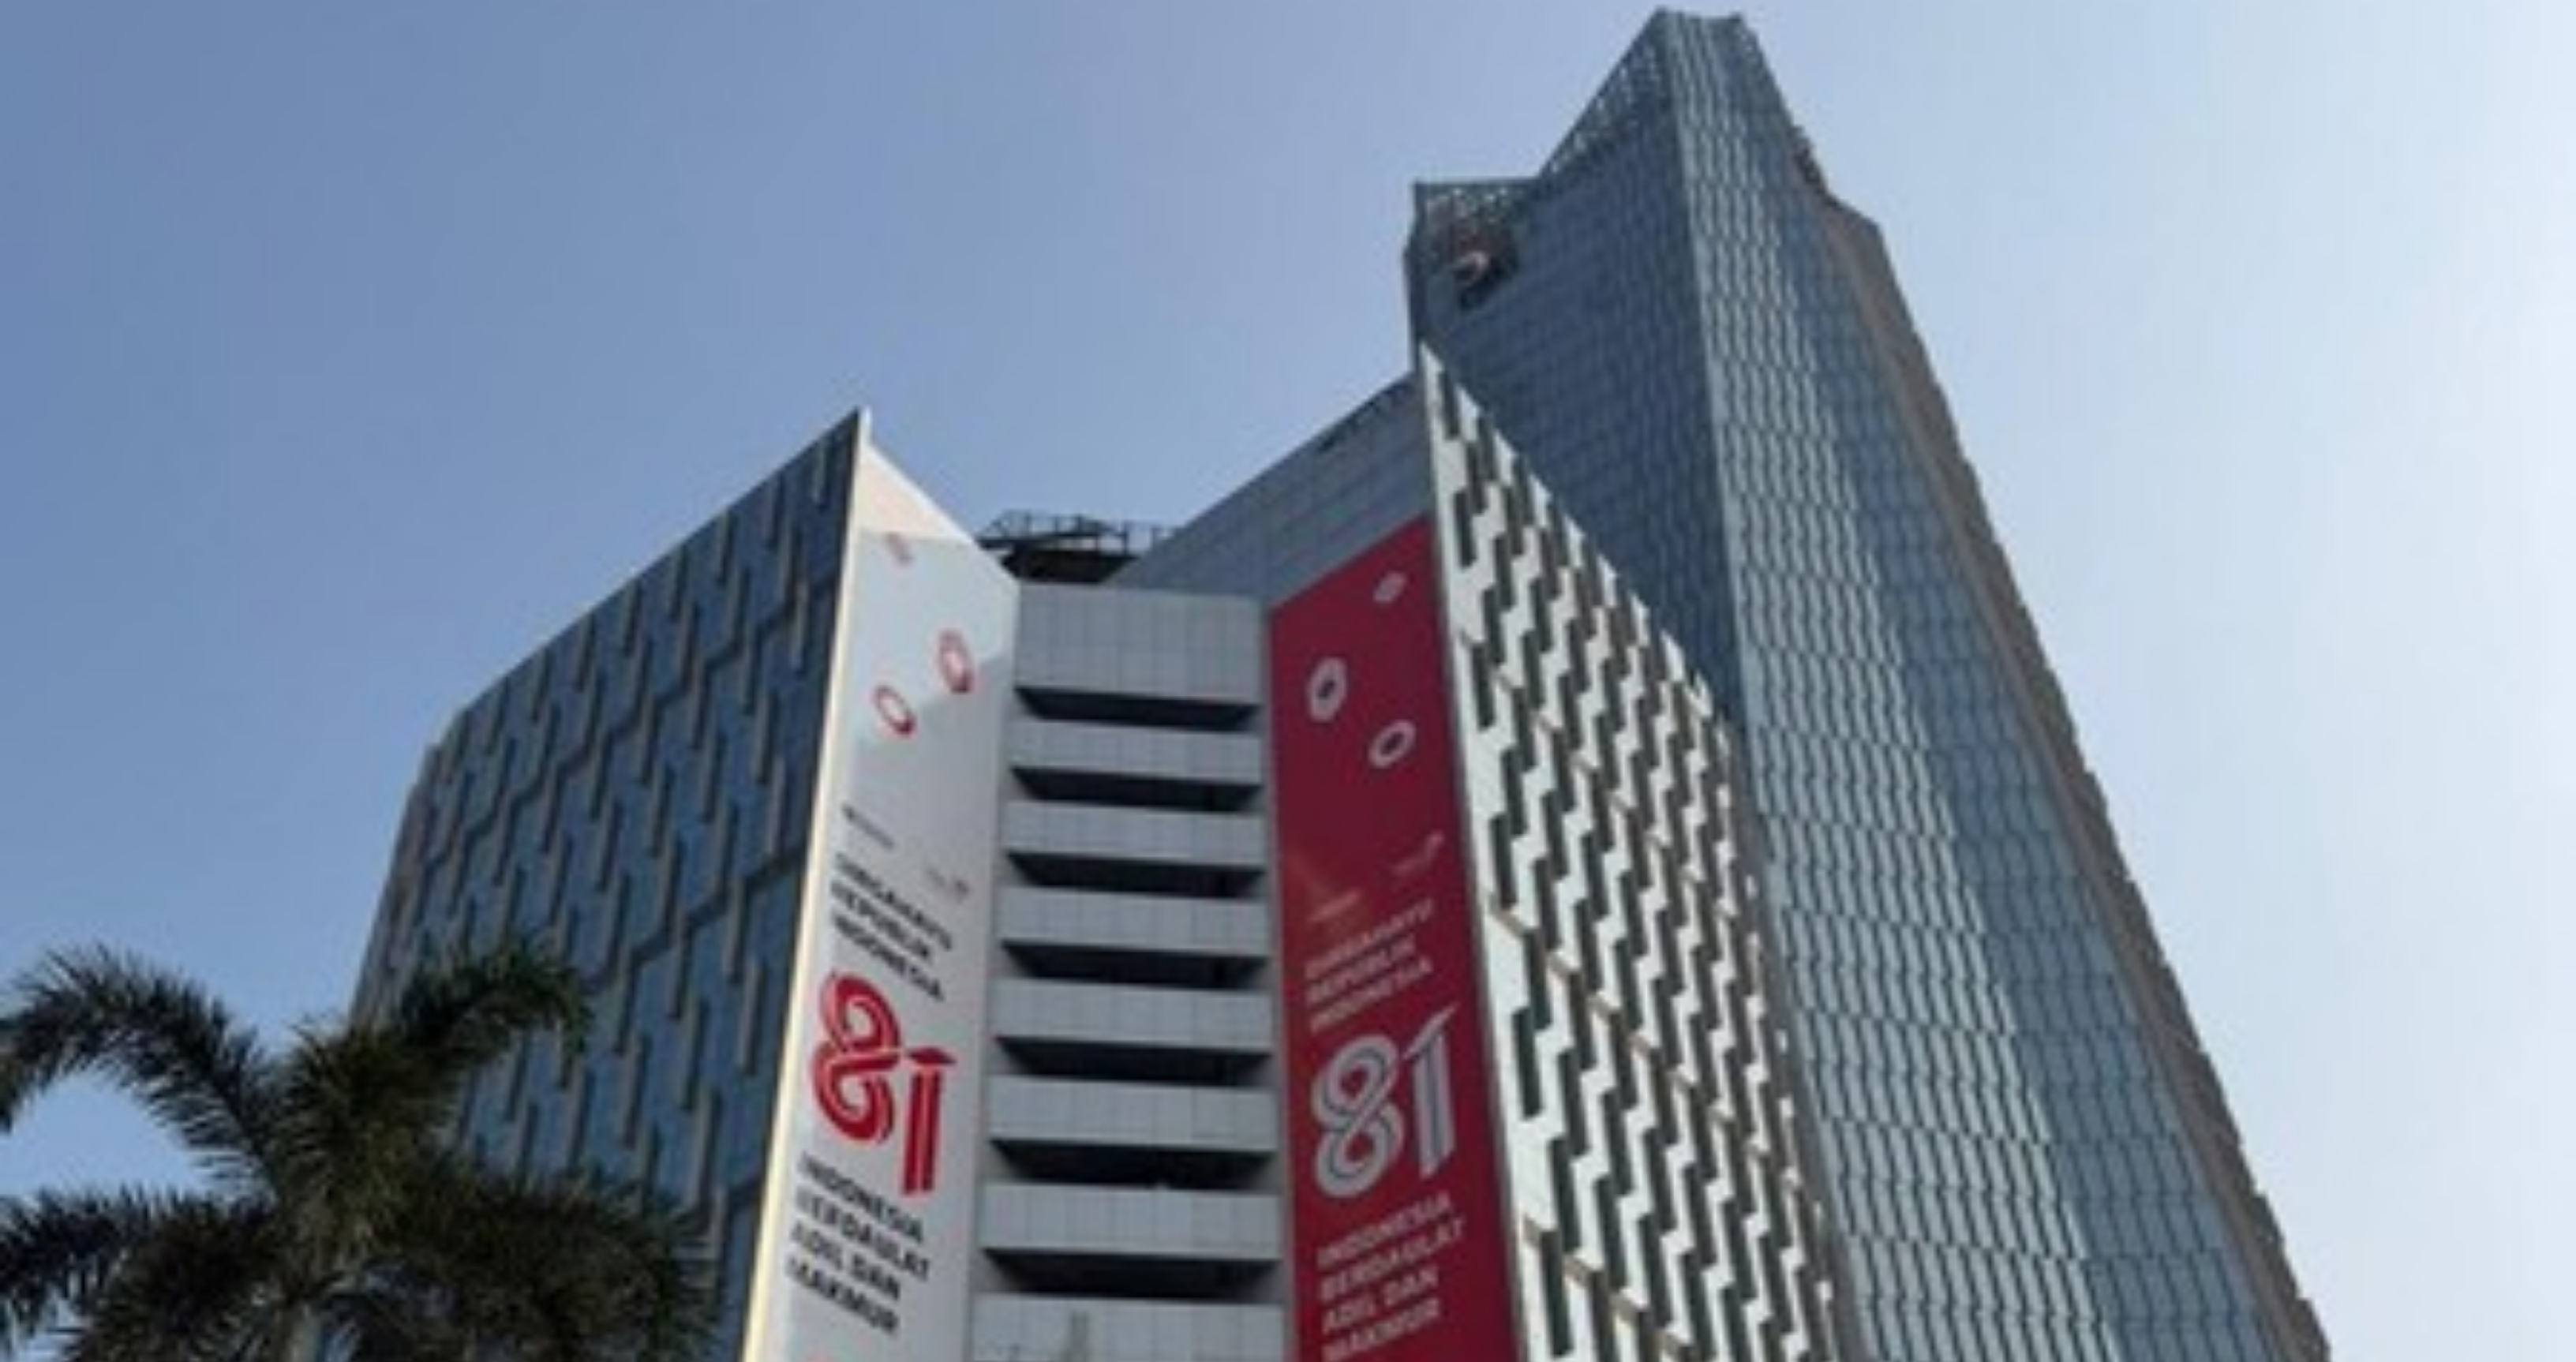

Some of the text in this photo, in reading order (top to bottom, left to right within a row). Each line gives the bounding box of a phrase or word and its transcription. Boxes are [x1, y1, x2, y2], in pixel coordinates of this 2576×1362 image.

[1306, 934, 1416, 1008] REPUBLIK
[1309, 955, 1435, 1035] INDONESIA
[812, 971, 956, 1197] 81
[1311, 1002, 1458, 1198] 81
[796, 1151, 923, 1245] INDONESIA
[1316, 1190, 1453, 1270] INDONESIA
[792, 1221, 900, 1302] ADIL DAN
[1321, 1217, 1465, 1301] BERDAULAT
[1321, 1298, 1440, 1362] MAKMUR
[1322, 1265, 1440, 1336] ADIL DAN
